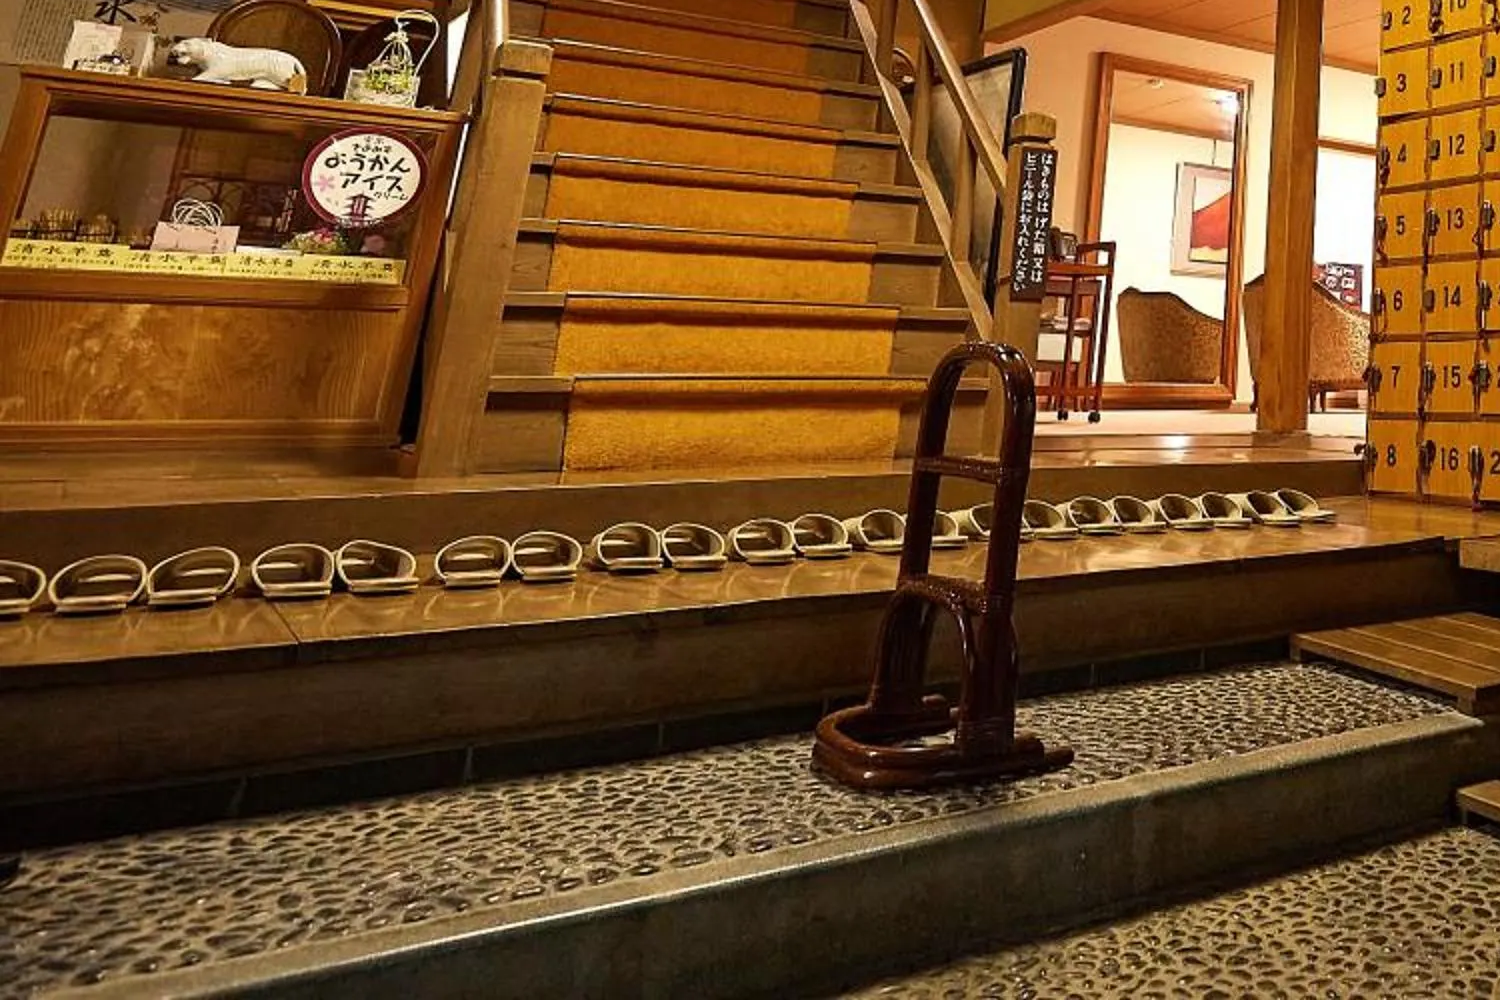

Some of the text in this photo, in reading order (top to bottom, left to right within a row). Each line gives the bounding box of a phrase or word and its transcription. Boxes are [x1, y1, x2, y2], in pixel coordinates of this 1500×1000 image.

[1401, 6, 1411, 25] 2
[1449, 61, 1464, 82] 11
[1396, 73, 1407, 92] 3
[1397, 143, 1407, 162] 4
[1448, 134, 1465, 156] 12
[325, 153, 410, 172] ようかん
[340, 172, 402, 192] アイス
[1396, 215, 1406, 235] 5
[1446, 208, 1464, 230] 13
[1393, 291, 1402, 311] 6
[1443, 286, 1461, 307] 14
[1392, 366, 1401, 385] 7
[1442, 365, 1461, 388] 15
[1387, 444, 1397, 465] 8
[1440, 448, 1459, 471] 16
